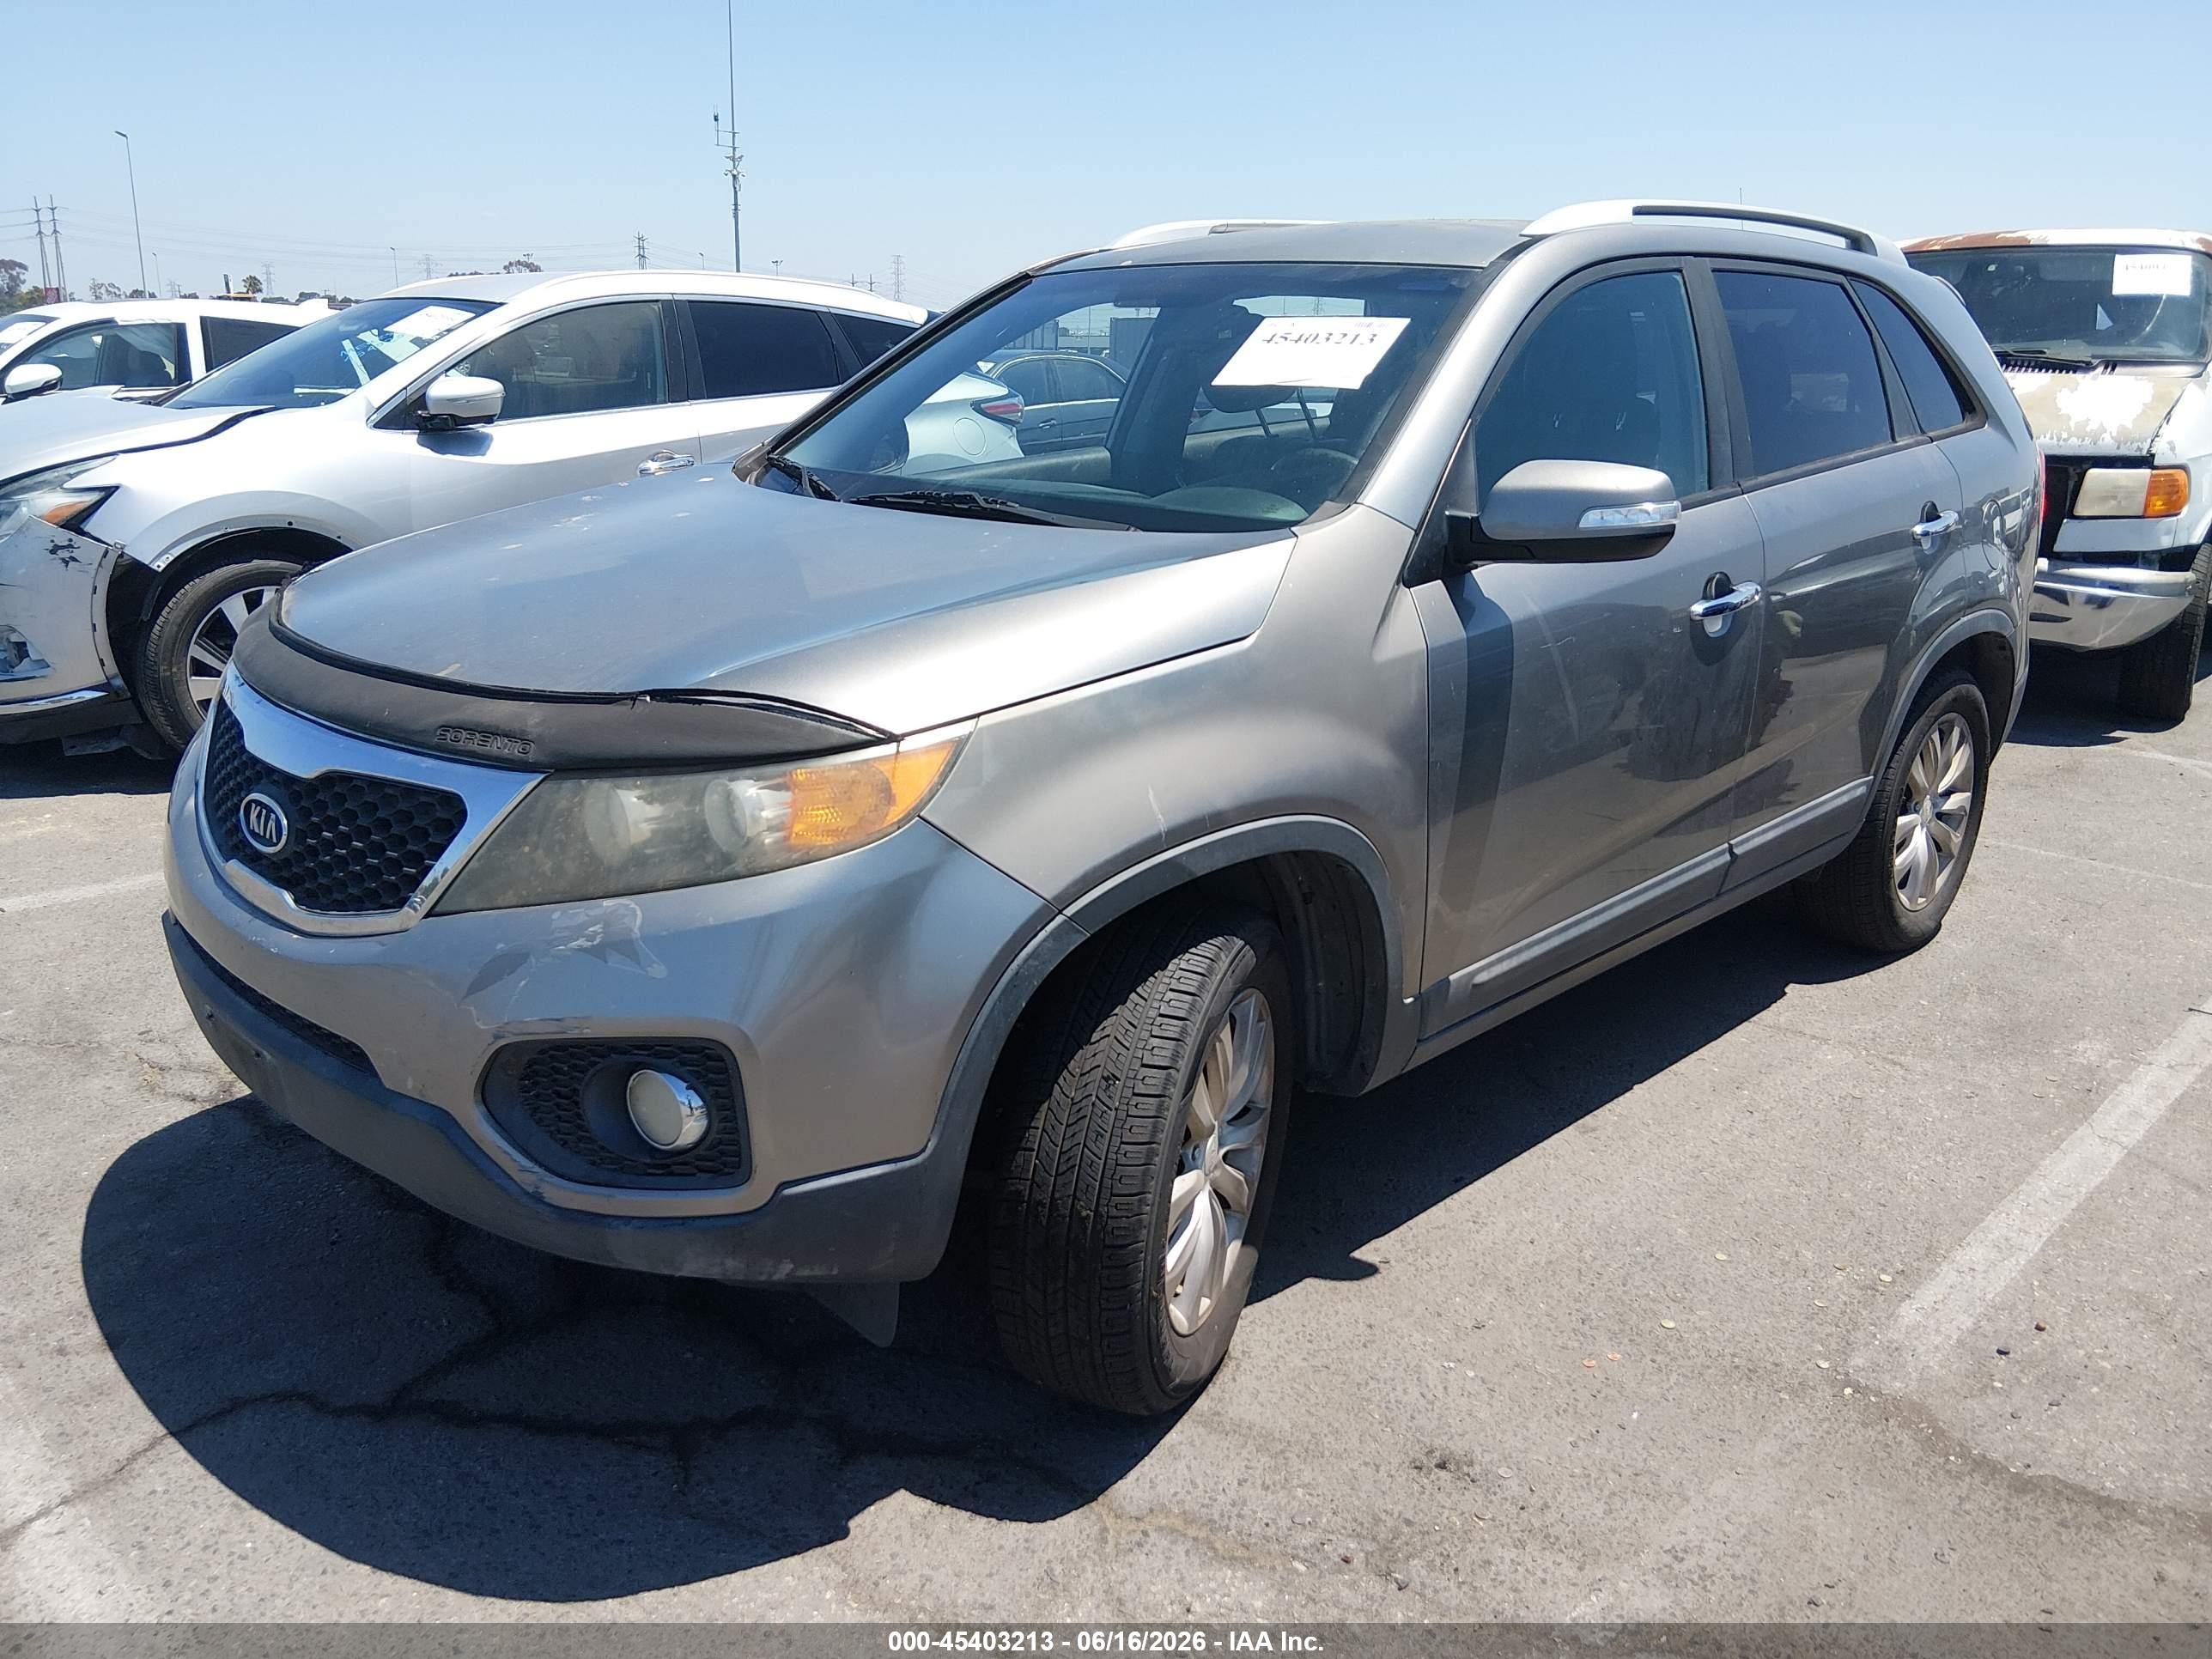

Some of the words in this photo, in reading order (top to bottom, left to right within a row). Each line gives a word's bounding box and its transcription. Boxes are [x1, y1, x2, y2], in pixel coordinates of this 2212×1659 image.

[1262, 332, 1377, 344] 45403213
[434, 725, 536, 756] SORENTO
[250, 802, 276, 843] KIA
